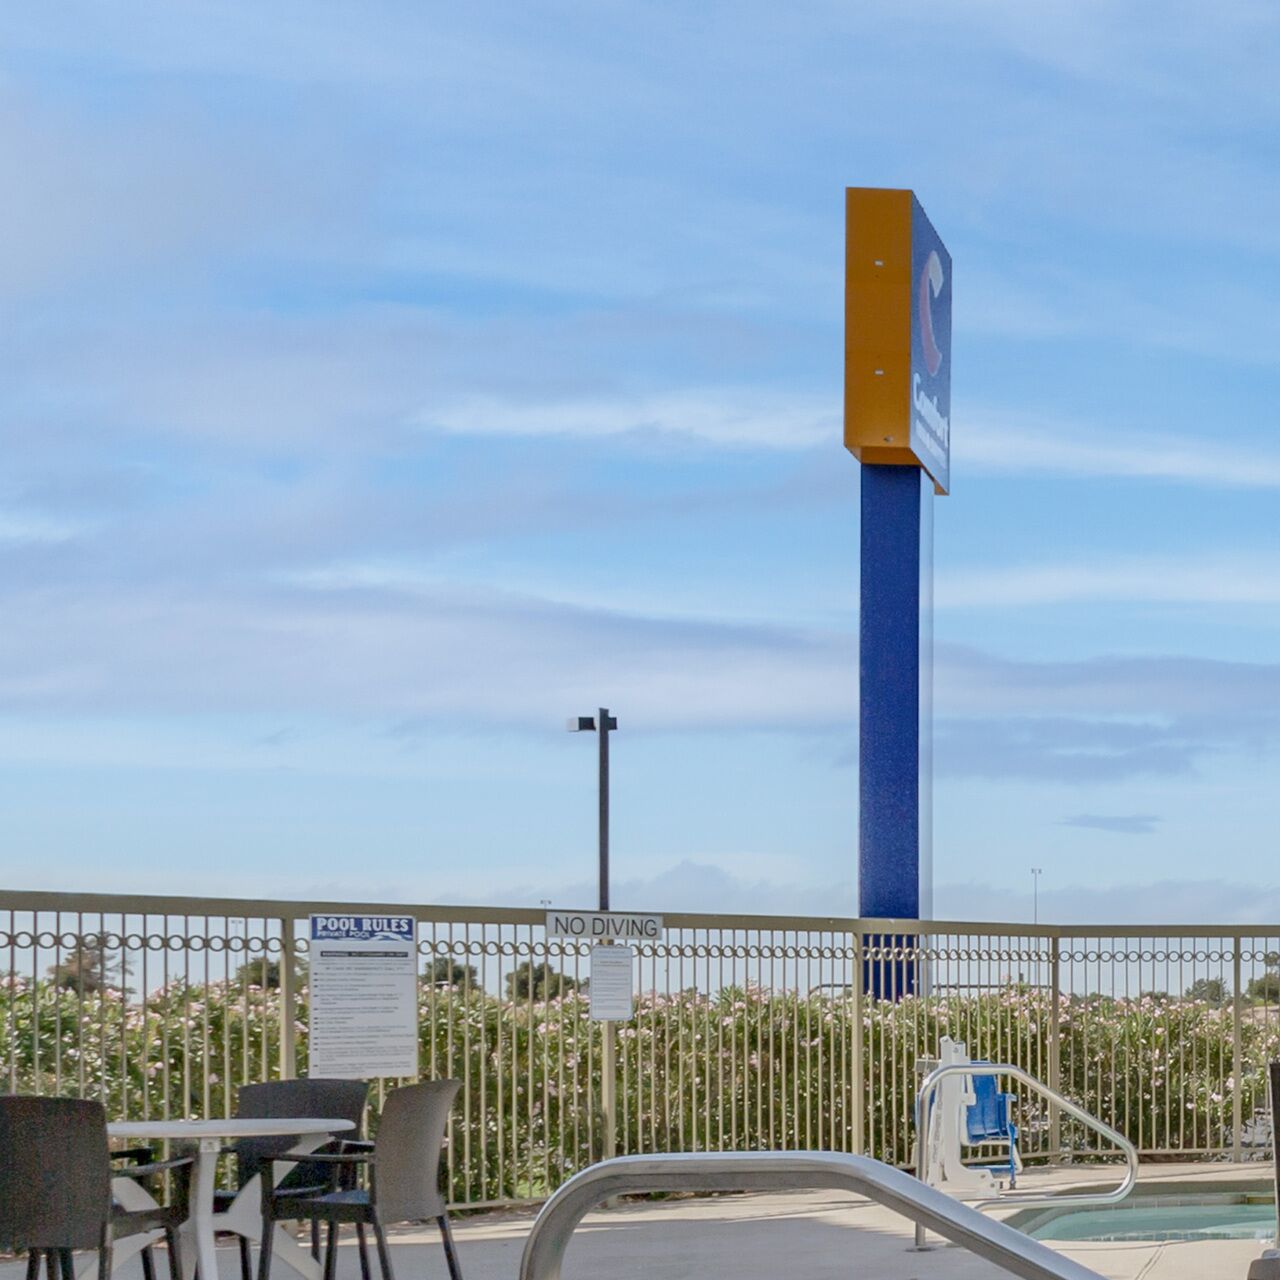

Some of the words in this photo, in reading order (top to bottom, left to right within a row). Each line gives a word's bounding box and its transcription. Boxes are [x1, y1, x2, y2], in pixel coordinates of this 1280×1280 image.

[317, 918, 358, 931] POOL
[362, 918, 409, 932] RULES
[555, 916, 585, 935] NO
[592, 917, 657, 937] DIVING
